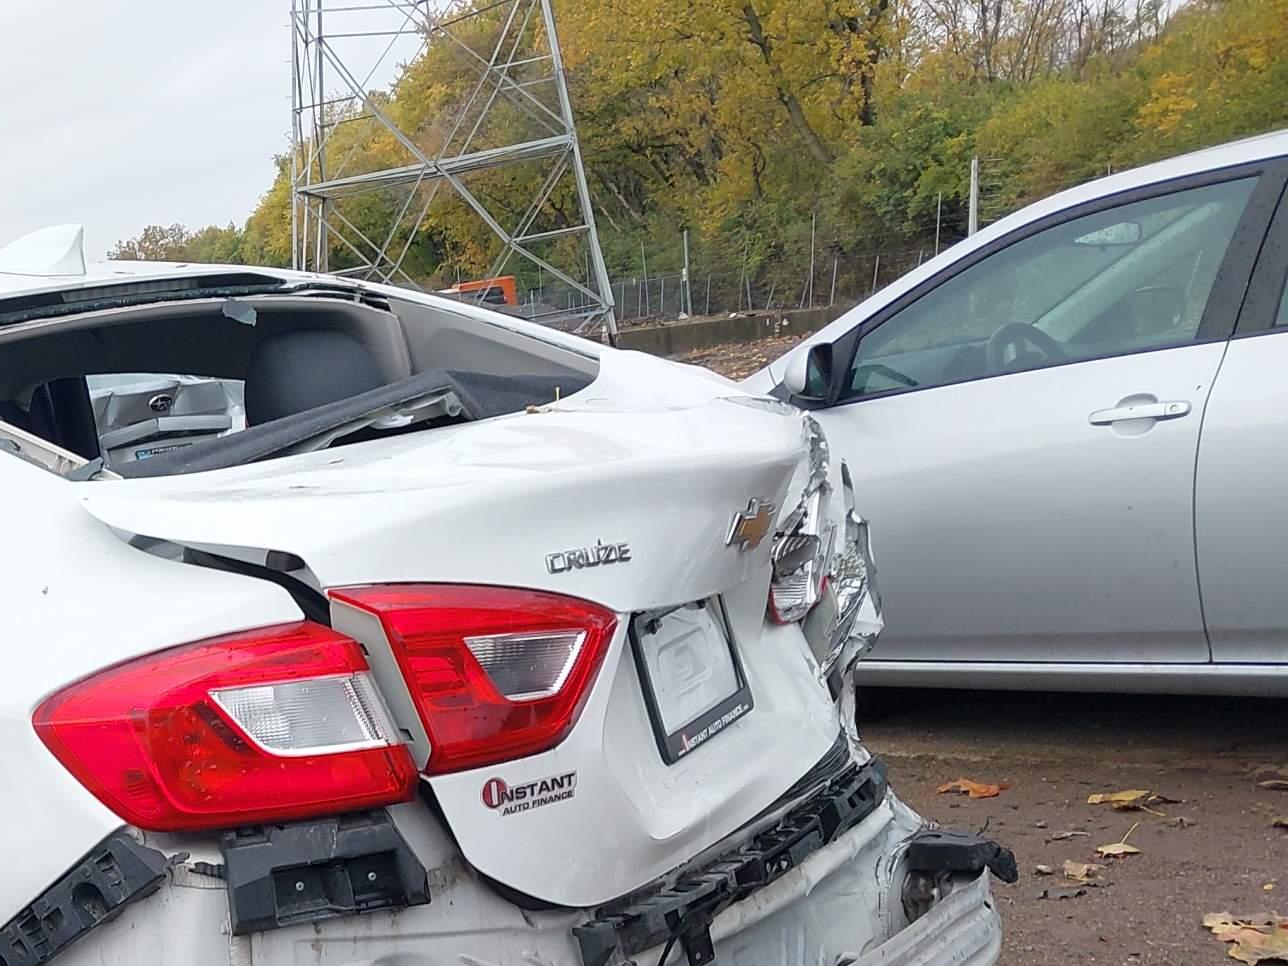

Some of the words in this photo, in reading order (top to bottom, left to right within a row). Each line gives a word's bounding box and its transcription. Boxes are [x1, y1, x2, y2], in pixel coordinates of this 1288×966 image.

[545, 539, 631, 574] CRUZE
[488, 772, 575, 807] INSTANT
[502, 801, 530, 817] AUTO
[531, 790, 574, 809] FINANCE
